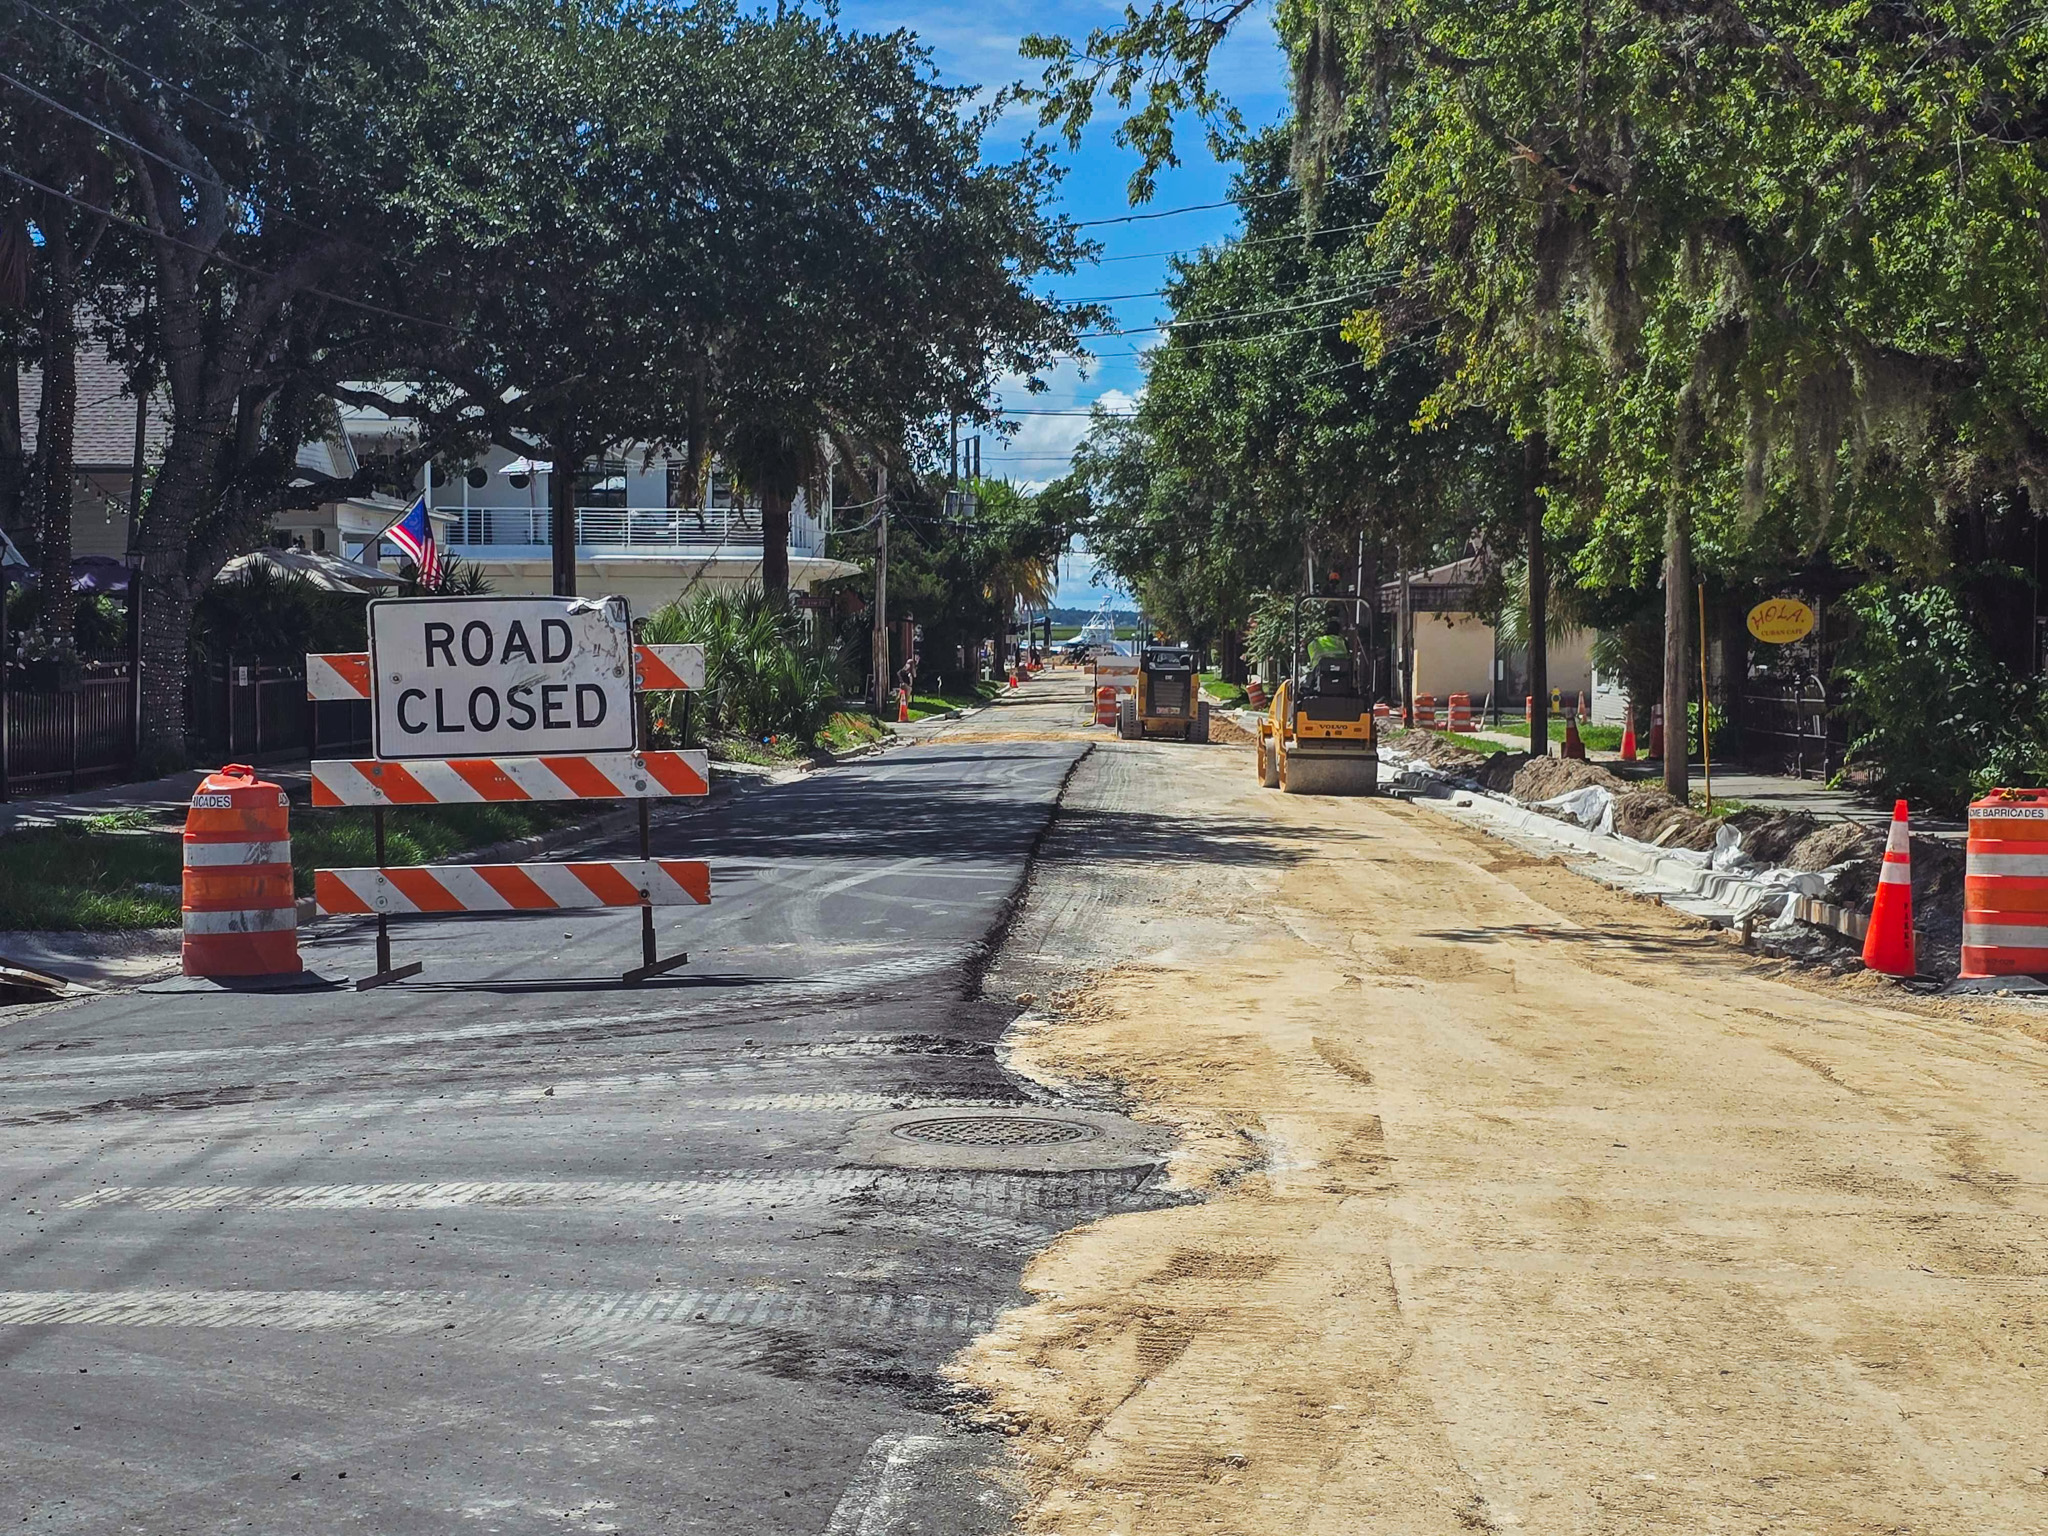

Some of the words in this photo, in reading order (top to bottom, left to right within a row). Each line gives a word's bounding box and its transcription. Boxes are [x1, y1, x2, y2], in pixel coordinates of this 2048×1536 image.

[424, 618, 573, 667] ROAD
[397, 682, 607, 735] CLOSED
[1983, 808, 2044, 818] BARRICADES
